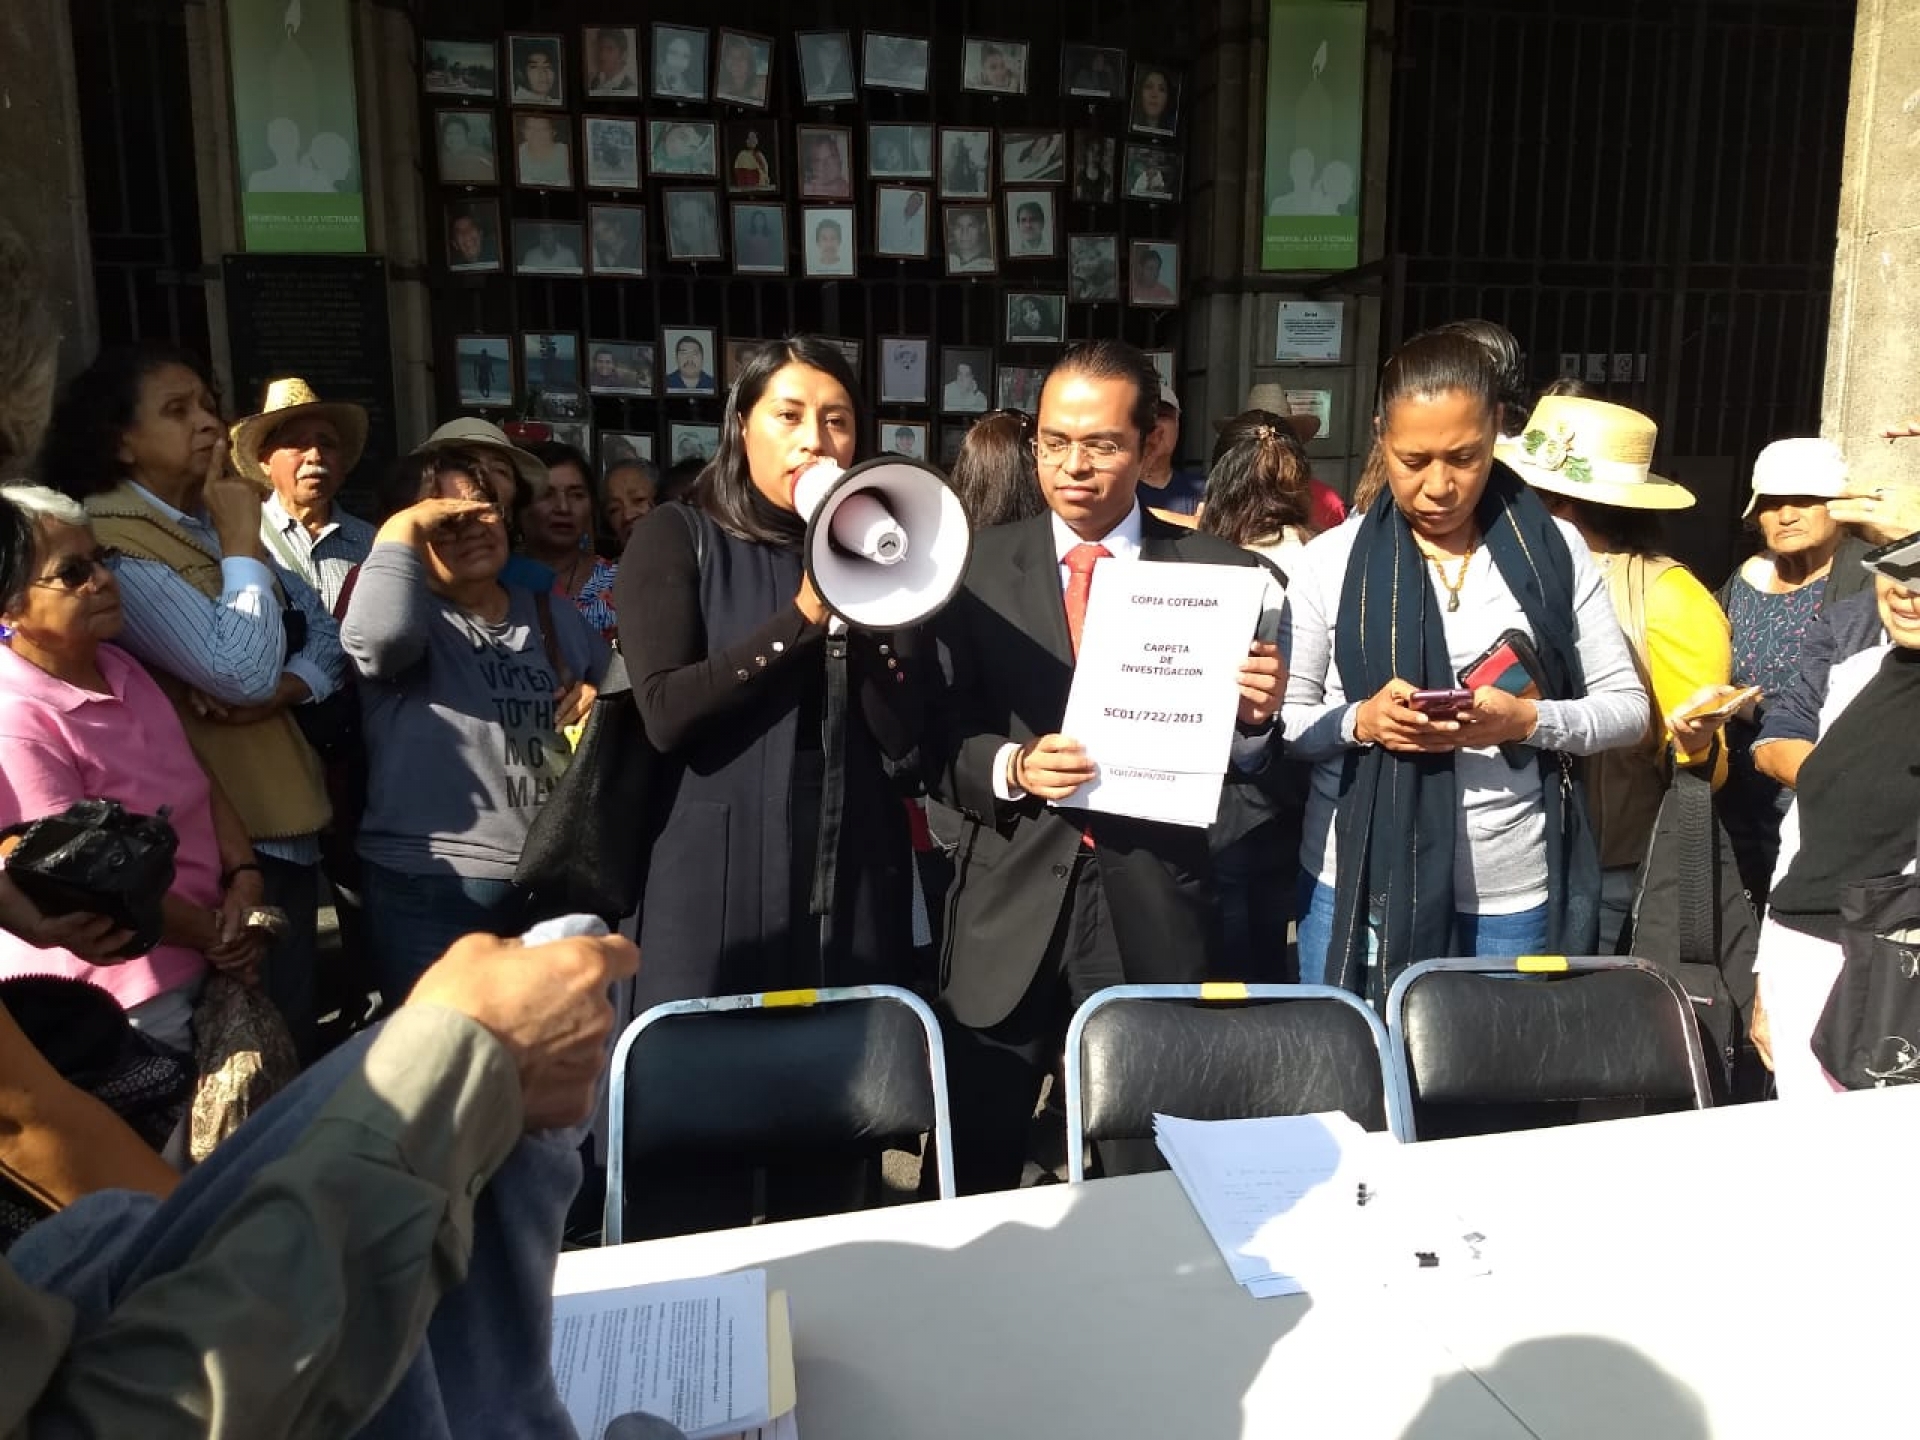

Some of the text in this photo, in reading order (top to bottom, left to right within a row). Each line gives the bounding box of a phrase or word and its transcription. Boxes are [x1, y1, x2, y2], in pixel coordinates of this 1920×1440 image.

[1131, 594, 1219, 608] COPIA COTEJADA
[1143, 642, 1190, 653] CARPETA
[1159, 655, 1174, 665] DE
[1120, 663, 1204, 677] INVESTIGACION
[1103, 707, 1204, 724] SC01/722/2013
